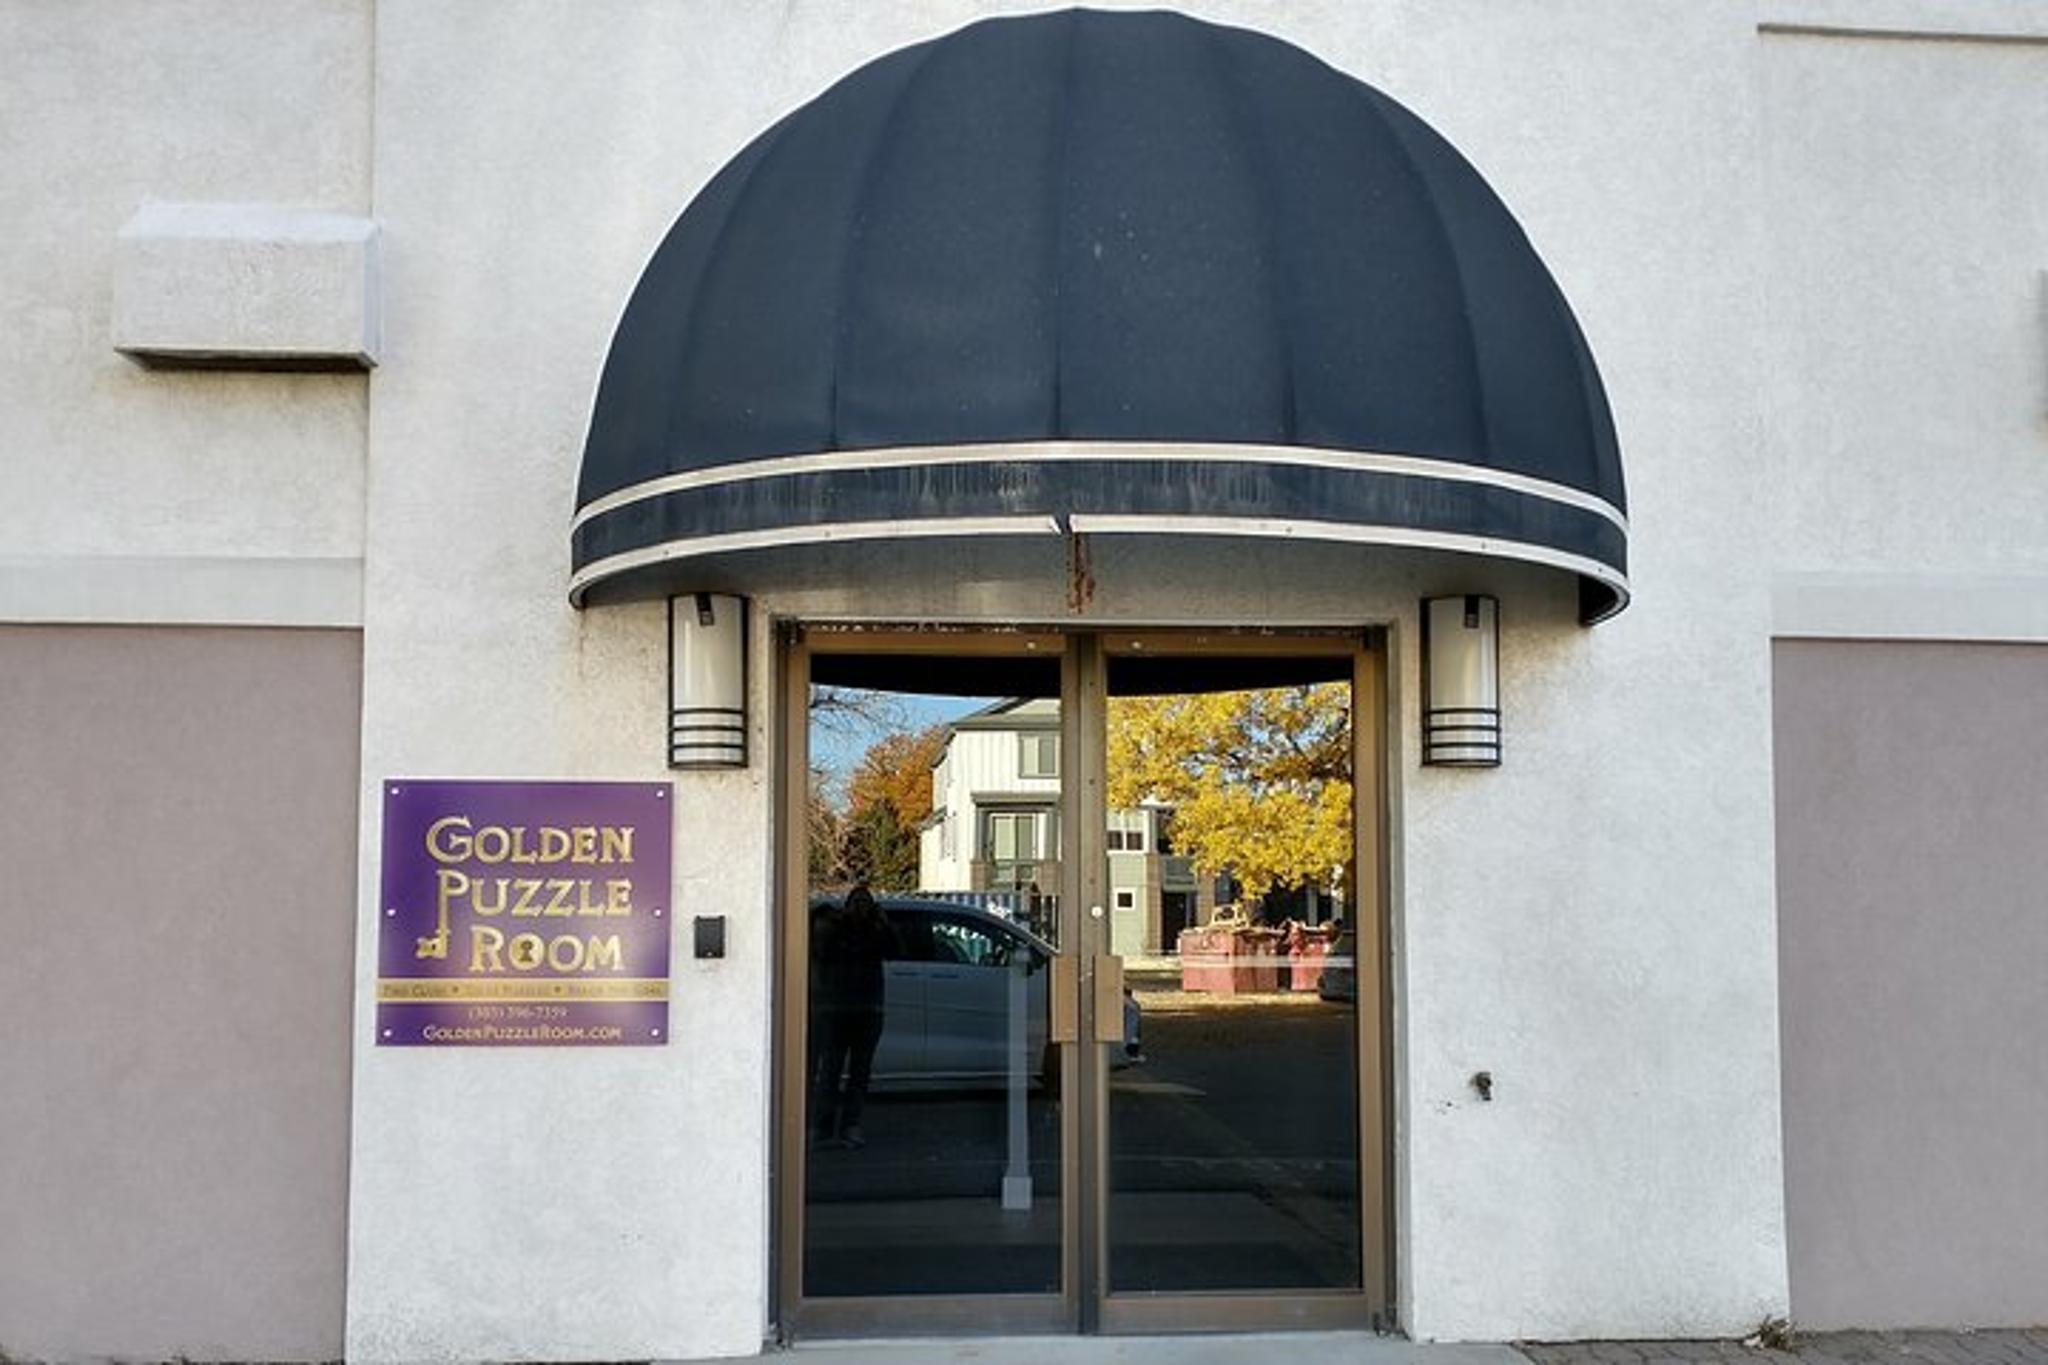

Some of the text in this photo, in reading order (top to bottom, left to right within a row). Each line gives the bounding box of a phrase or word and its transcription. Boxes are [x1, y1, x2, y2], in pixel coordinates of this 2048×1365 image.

[425, 815, 635, 864] GOLDEN
[436, 869, 633, 932] PUZZLE
[469, 924, 626, 973] ROOM
